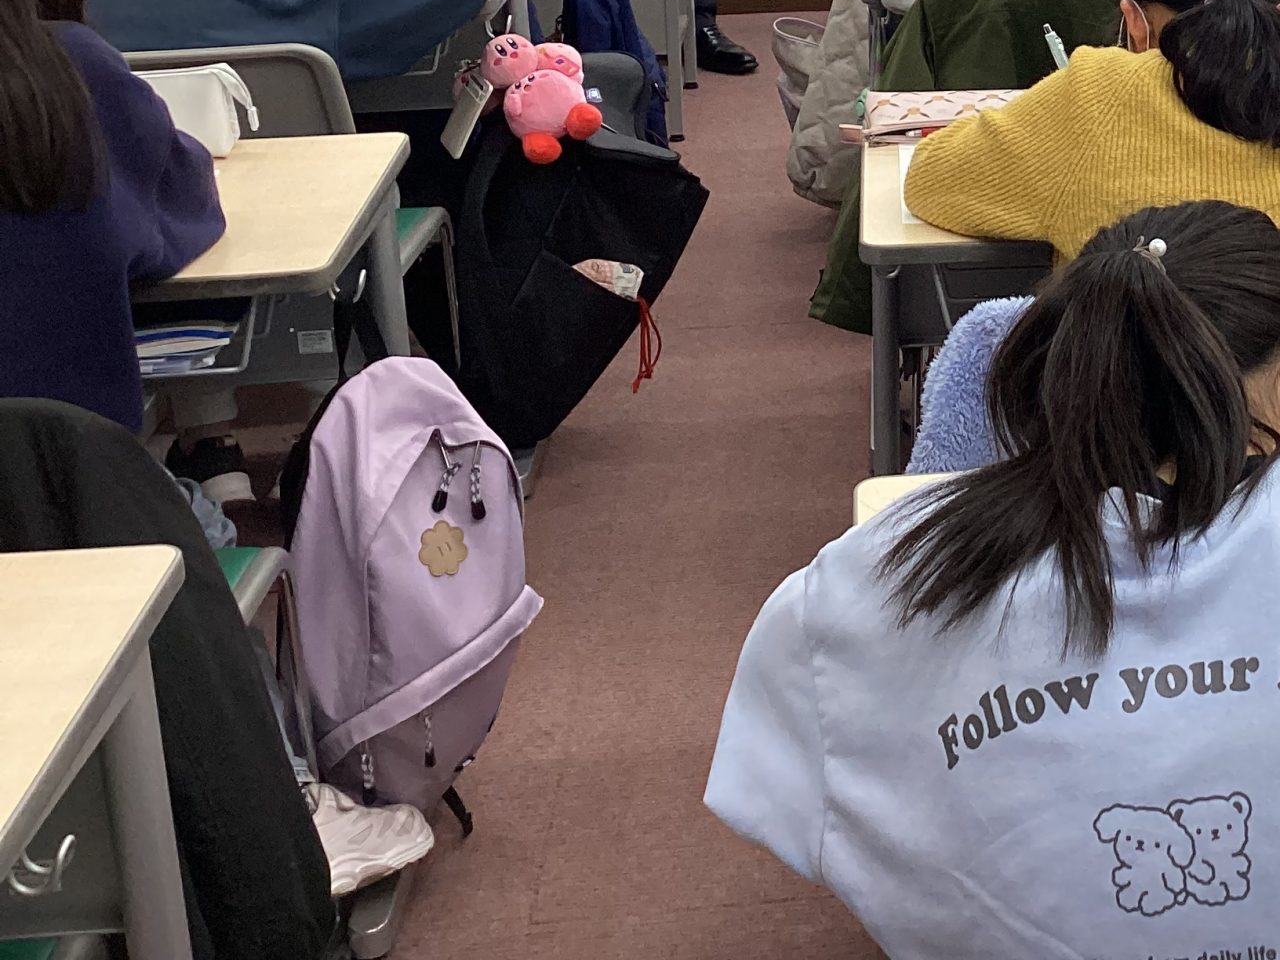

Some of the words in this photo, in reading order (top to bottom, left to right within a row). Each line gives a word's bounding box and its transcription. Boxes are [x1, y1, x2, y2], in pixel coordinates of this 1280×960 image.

[937, 671, 1100, 770] Follow
[1119, 656, 1260, 714] your
[1247, 945, 1277, 960] life
